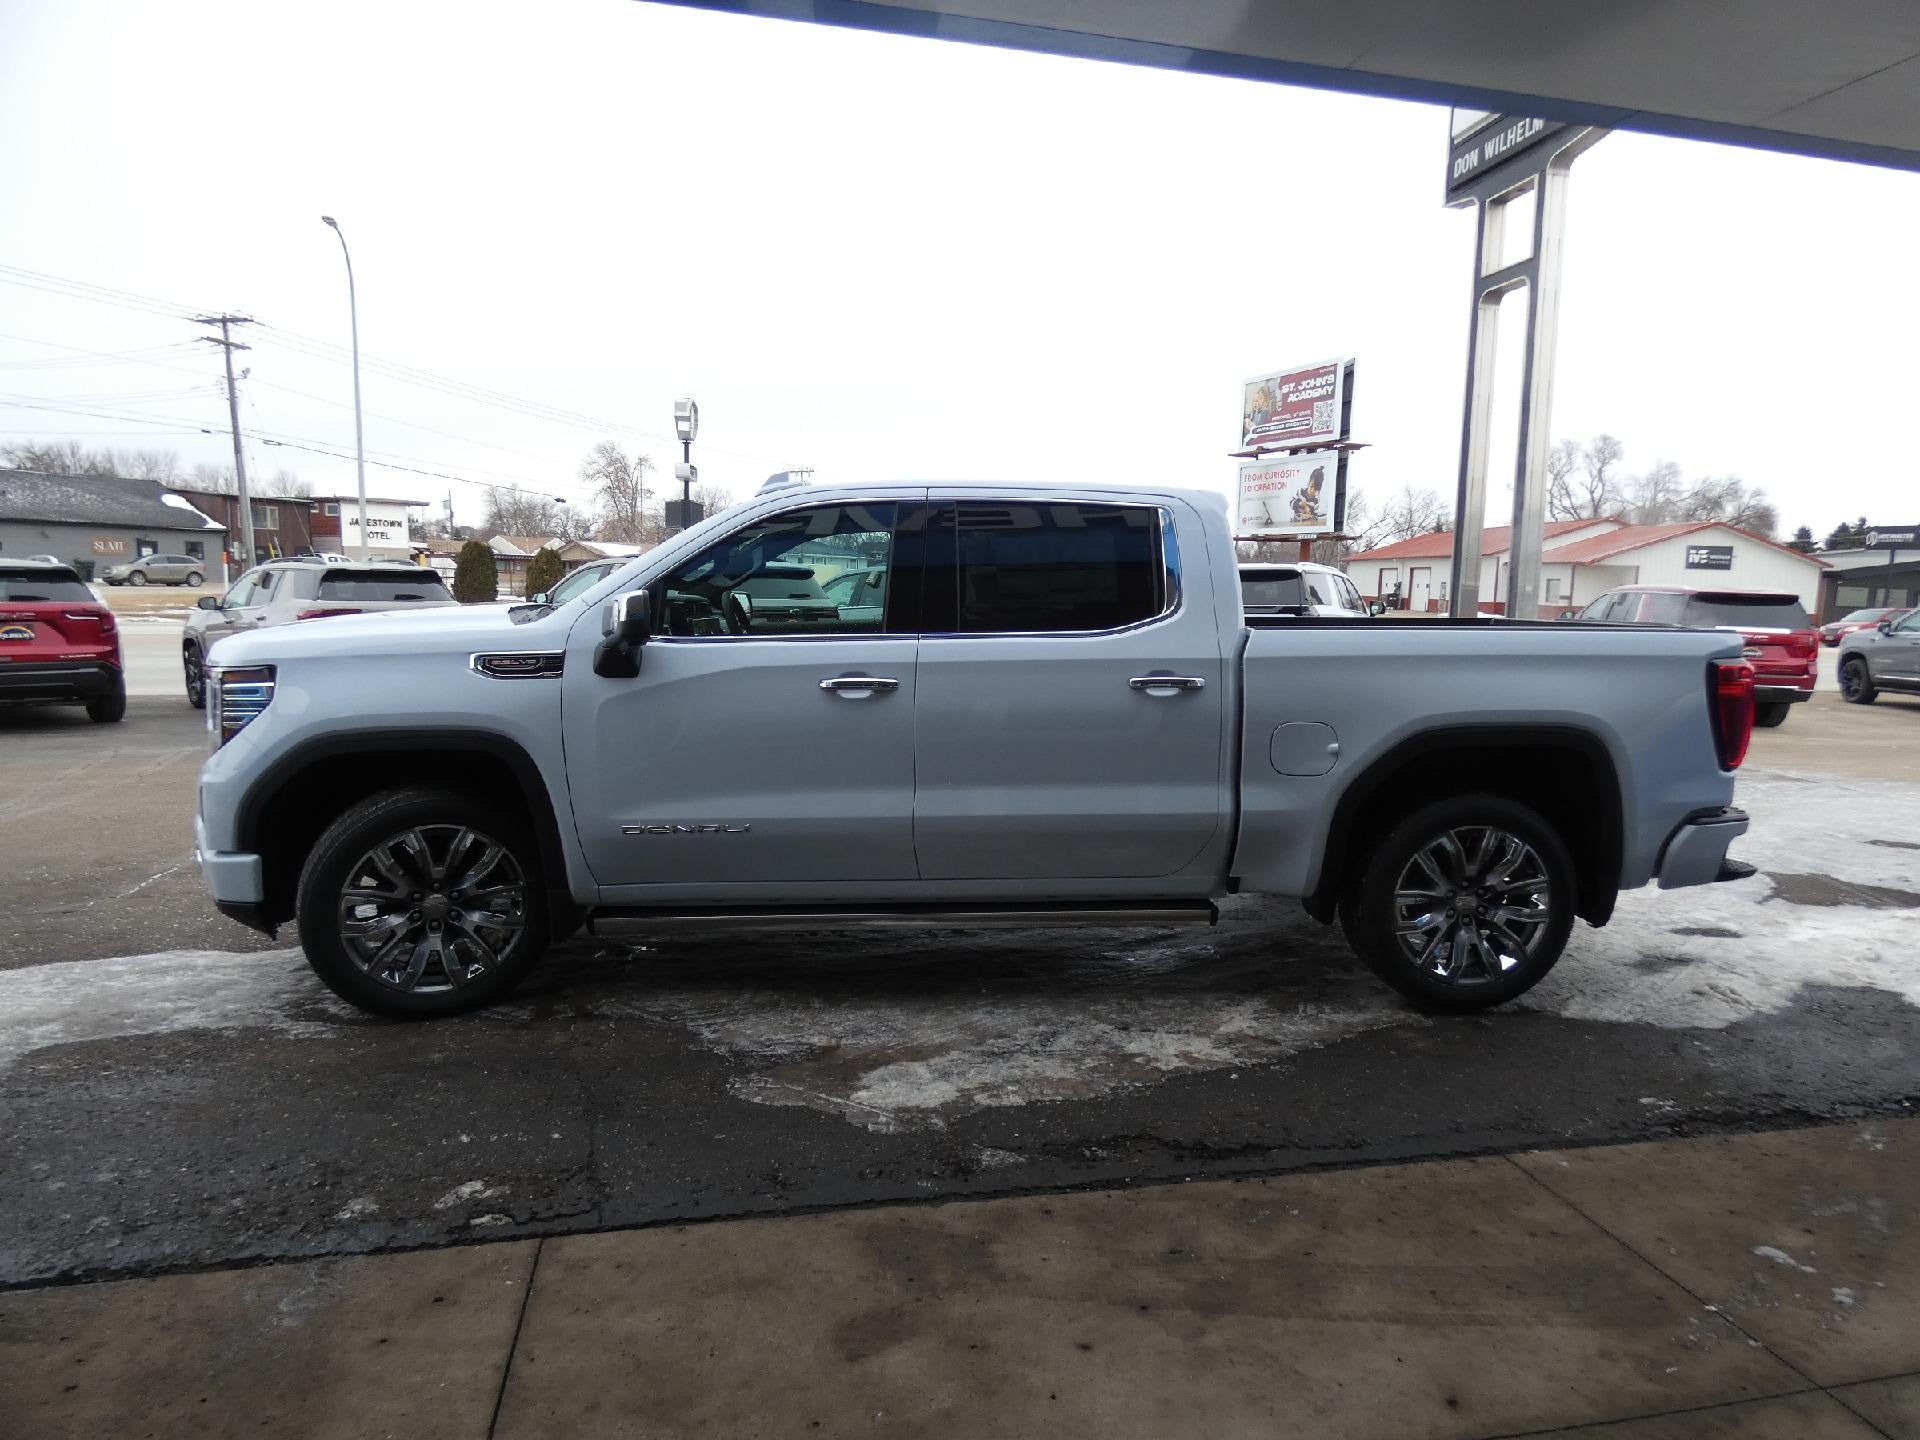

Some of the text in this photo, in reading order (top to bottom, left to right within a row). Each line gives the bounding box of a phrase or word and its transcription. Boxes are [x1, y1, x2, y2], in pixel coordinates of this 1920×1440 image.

[1453, 117, 1546, 179] DON WILHELM
[1281, 374, 1335, 394] ST. JOHN'S
[1287, 385, 1334, 403] ACADEMY
[1244, 473, 1263, 482] FROM
[1253, 481, 1288, 492] CREATION
[349, 517, 403, 528] JAESTOWN
[366, 531, 391, 540] OTEL
[620, 823, 751, 834] DENALI
